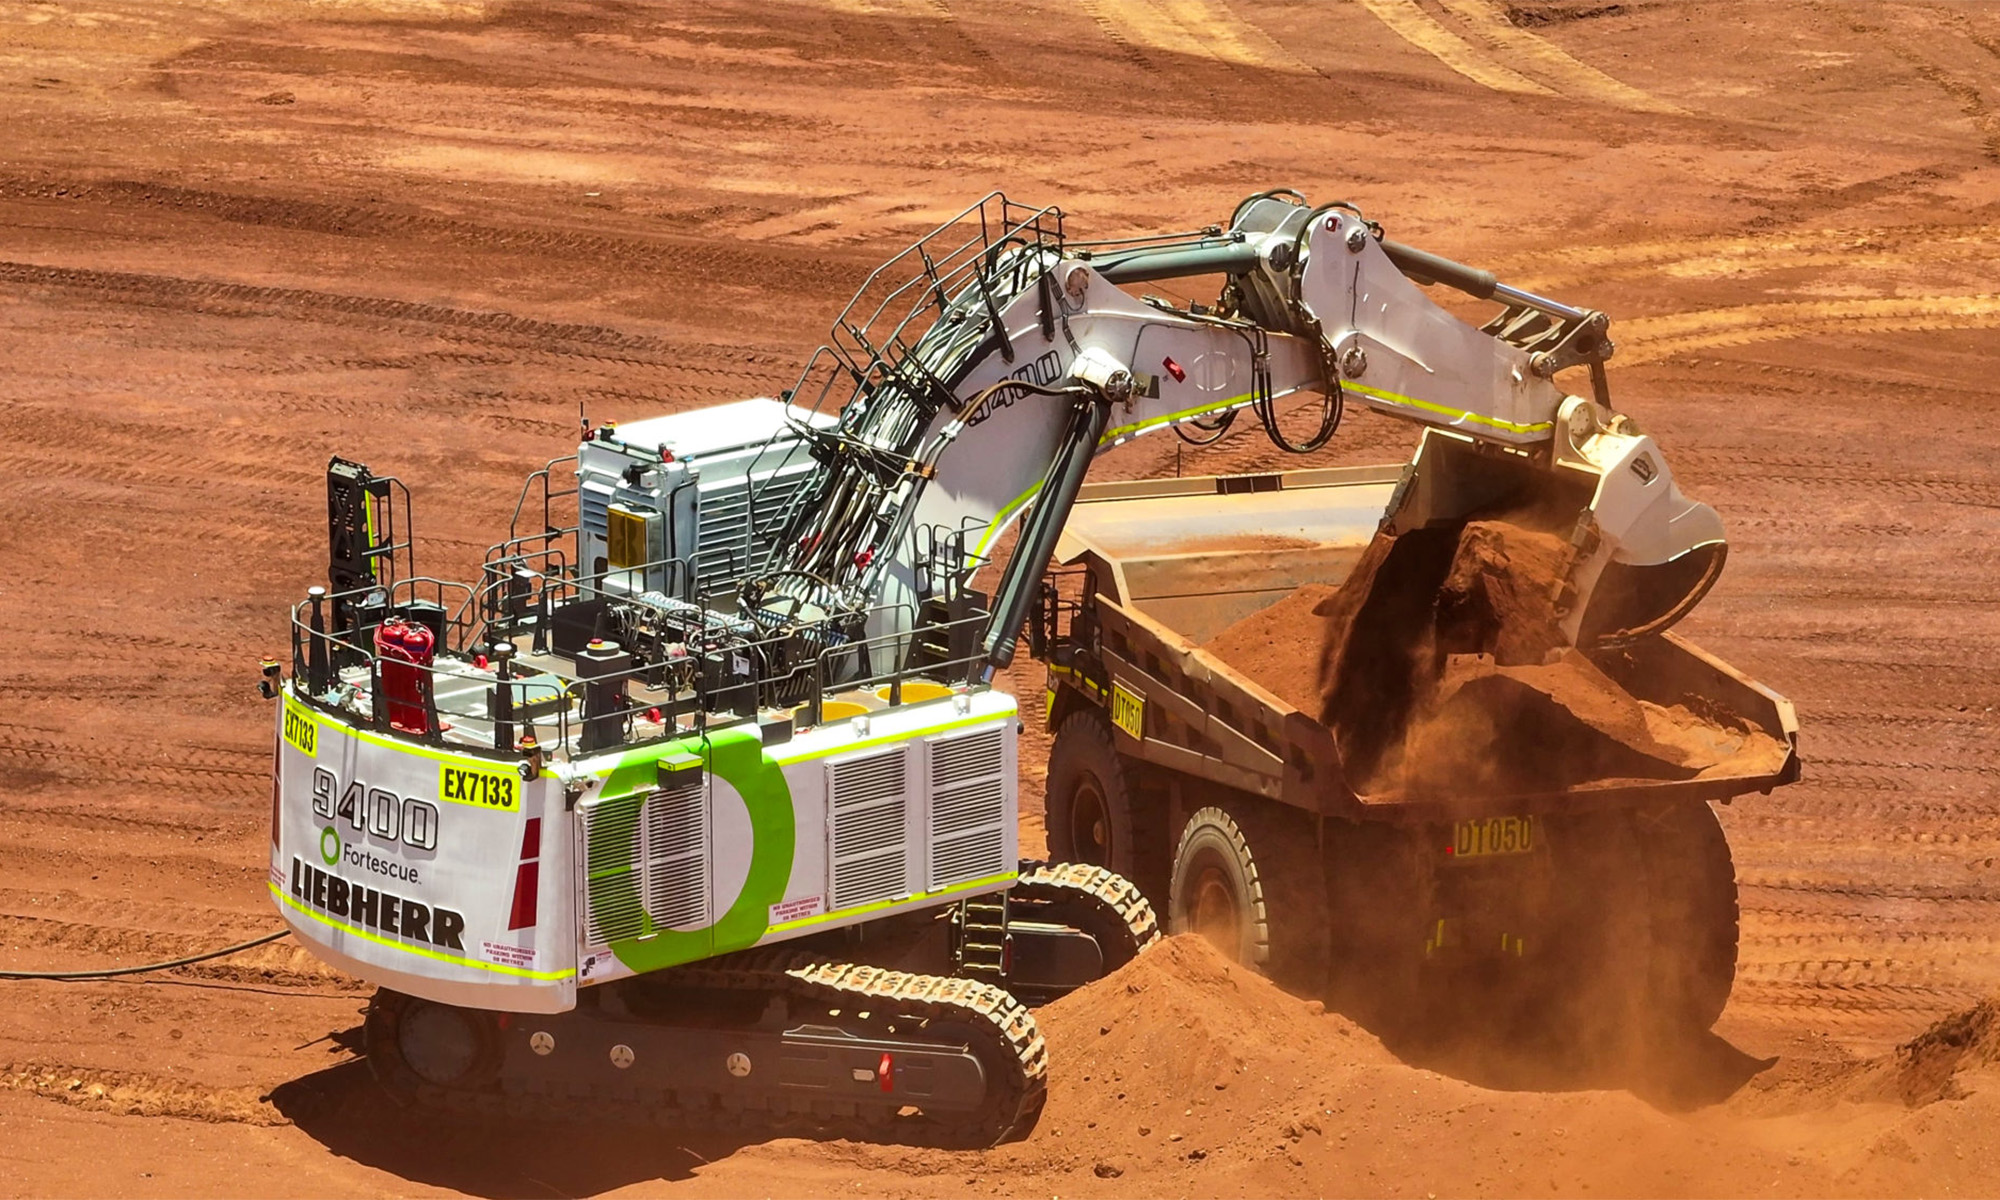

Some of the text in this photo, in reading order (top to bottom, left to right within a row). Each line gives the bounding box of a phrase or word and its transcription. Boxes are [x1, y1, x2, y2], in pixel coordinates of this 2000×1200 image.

[285, 708, 314, 752] EX7133
[1115, 692, 1140, 735] DT050
[313, 766, 438, 851] 9400
[444, 768, 513, 807] EX7133
[1458, 818, 1531, 855] DT050
[291, 857, 466, 952] LIEBHERR
